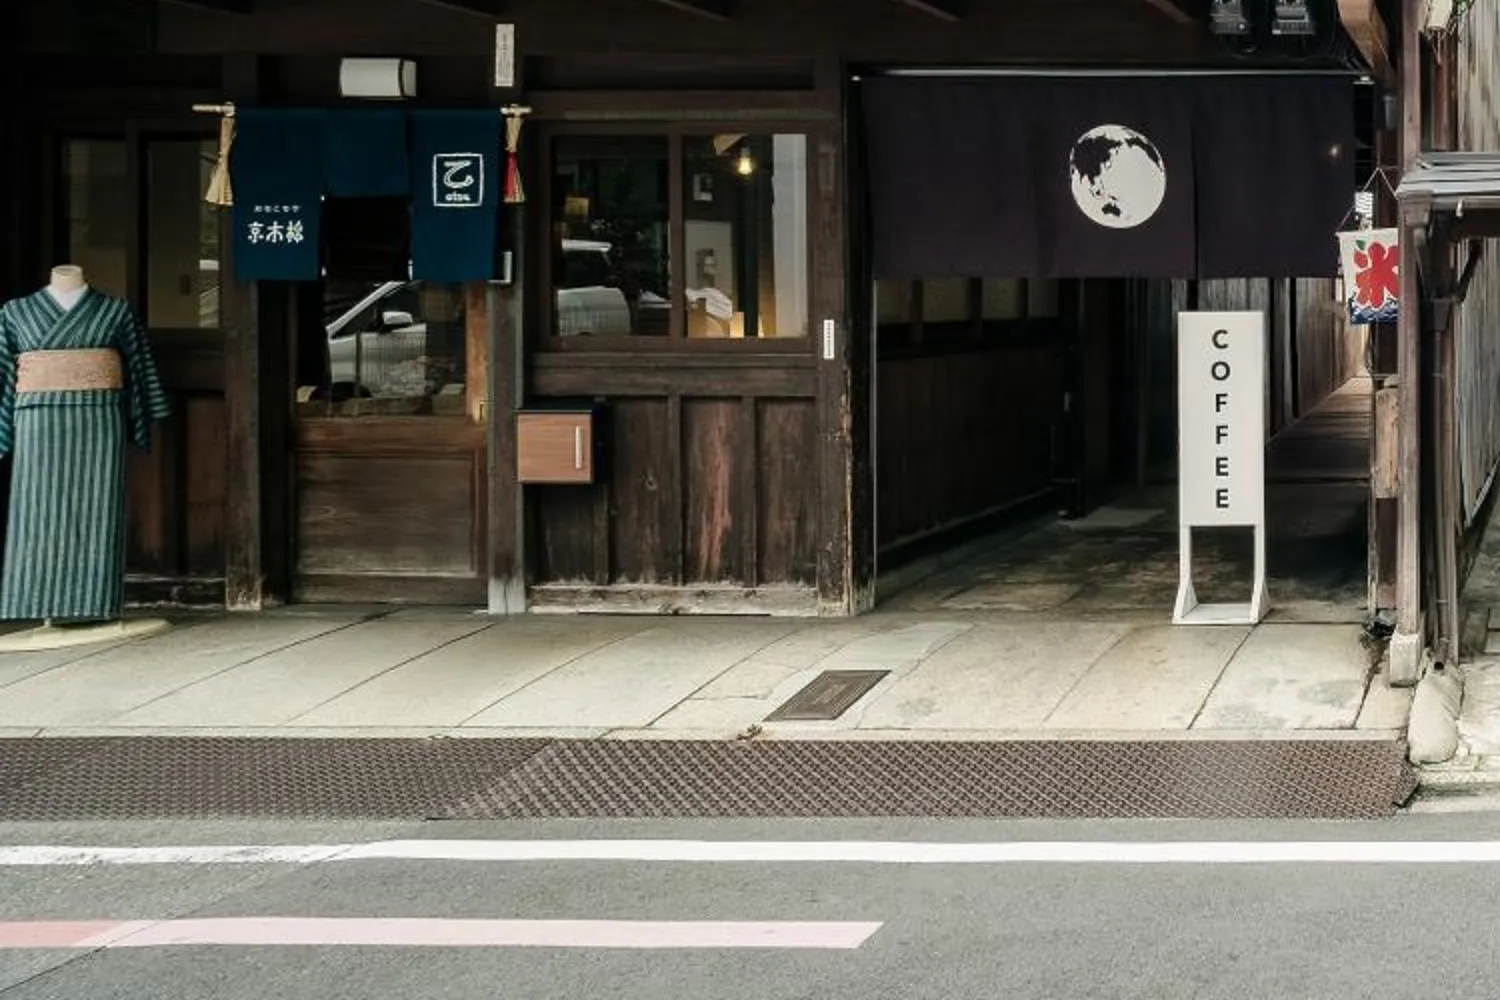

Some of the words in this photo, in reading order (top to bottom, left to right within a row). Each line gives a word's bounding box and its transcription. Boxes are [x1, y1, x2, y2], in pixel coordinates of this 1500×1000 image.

[443, 160, 474, 188] 乙
[1353, 241, 1398, 309] 氷
[1211, 329, 1230, 509] COFFEE
